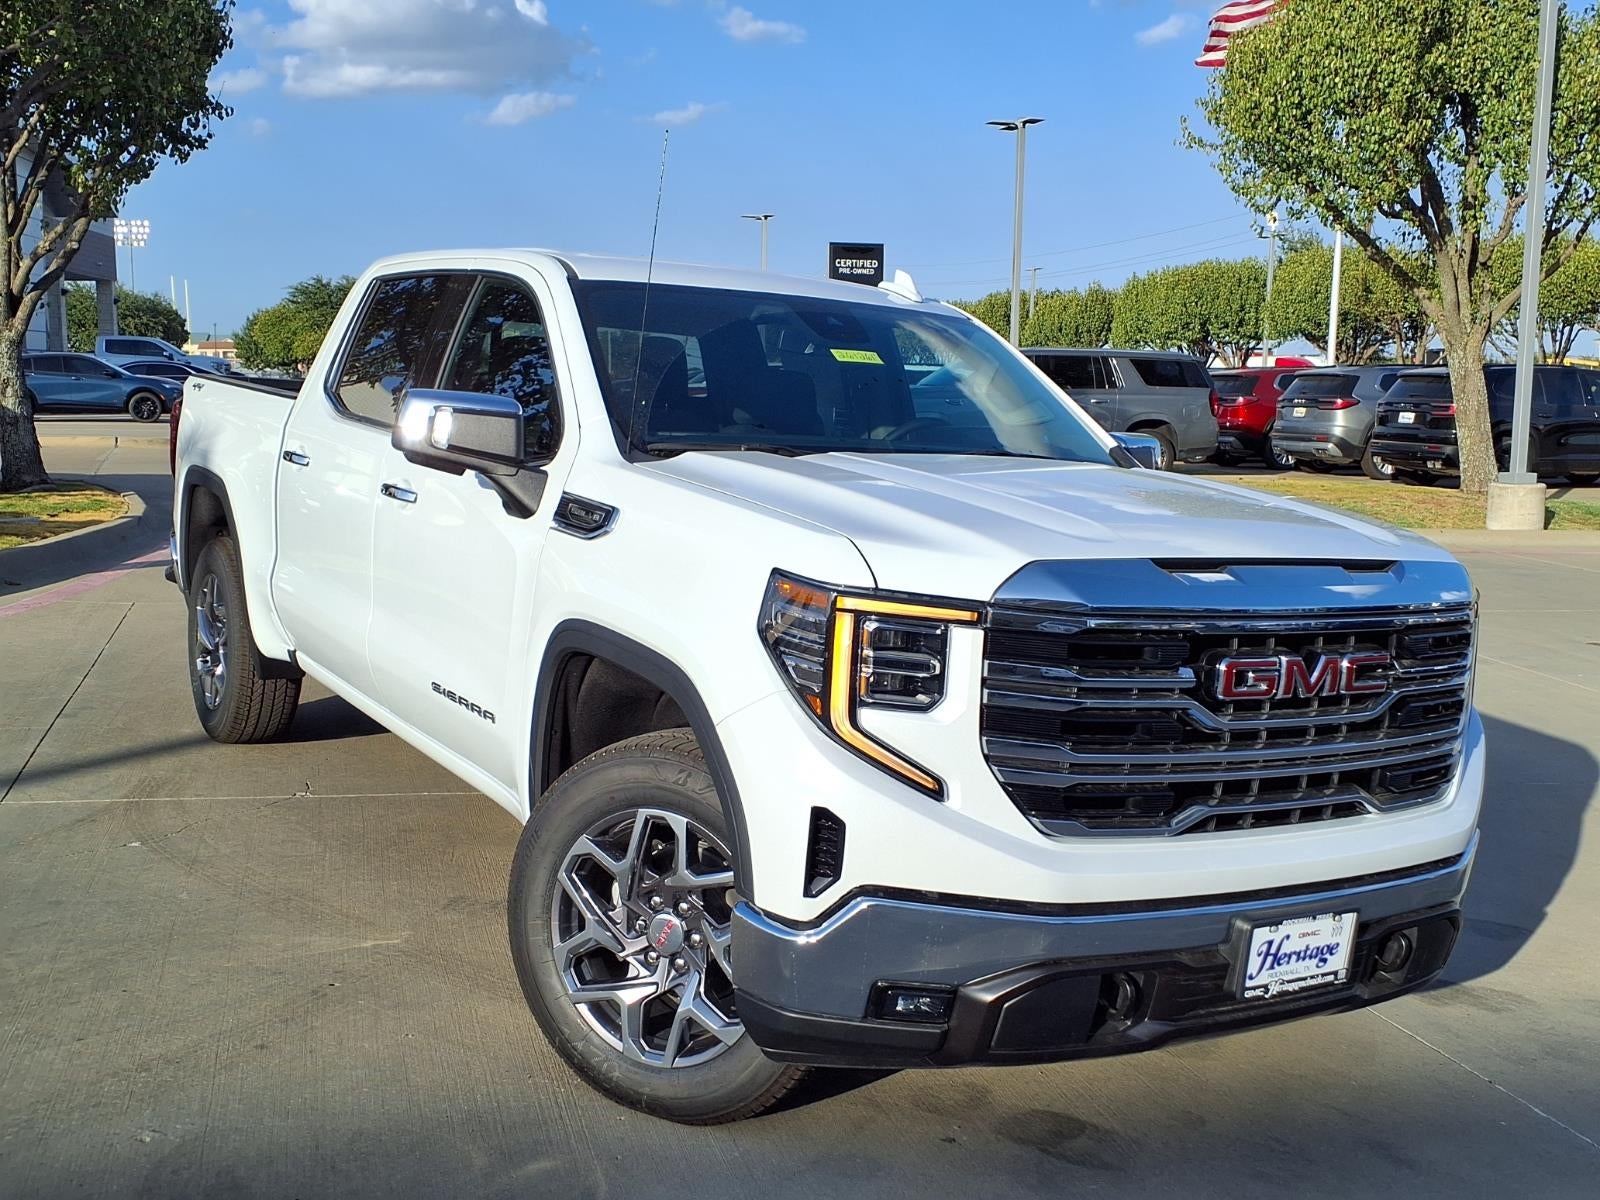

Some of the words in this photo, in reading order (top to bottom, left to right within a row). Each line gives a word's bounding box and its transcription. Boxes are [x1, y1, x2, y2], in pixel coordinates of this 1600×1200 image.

[835, 258, 879, 268] CERTIFIED
[838, 267, 875, 275] PRE-OWNED
[1216, 652, 1391, 701] GMC
[431, 681, 496, 724] SIERRA
[1298, 929, 1321, 939] GMC
[1248, 933, 1340, 981] Heritage
